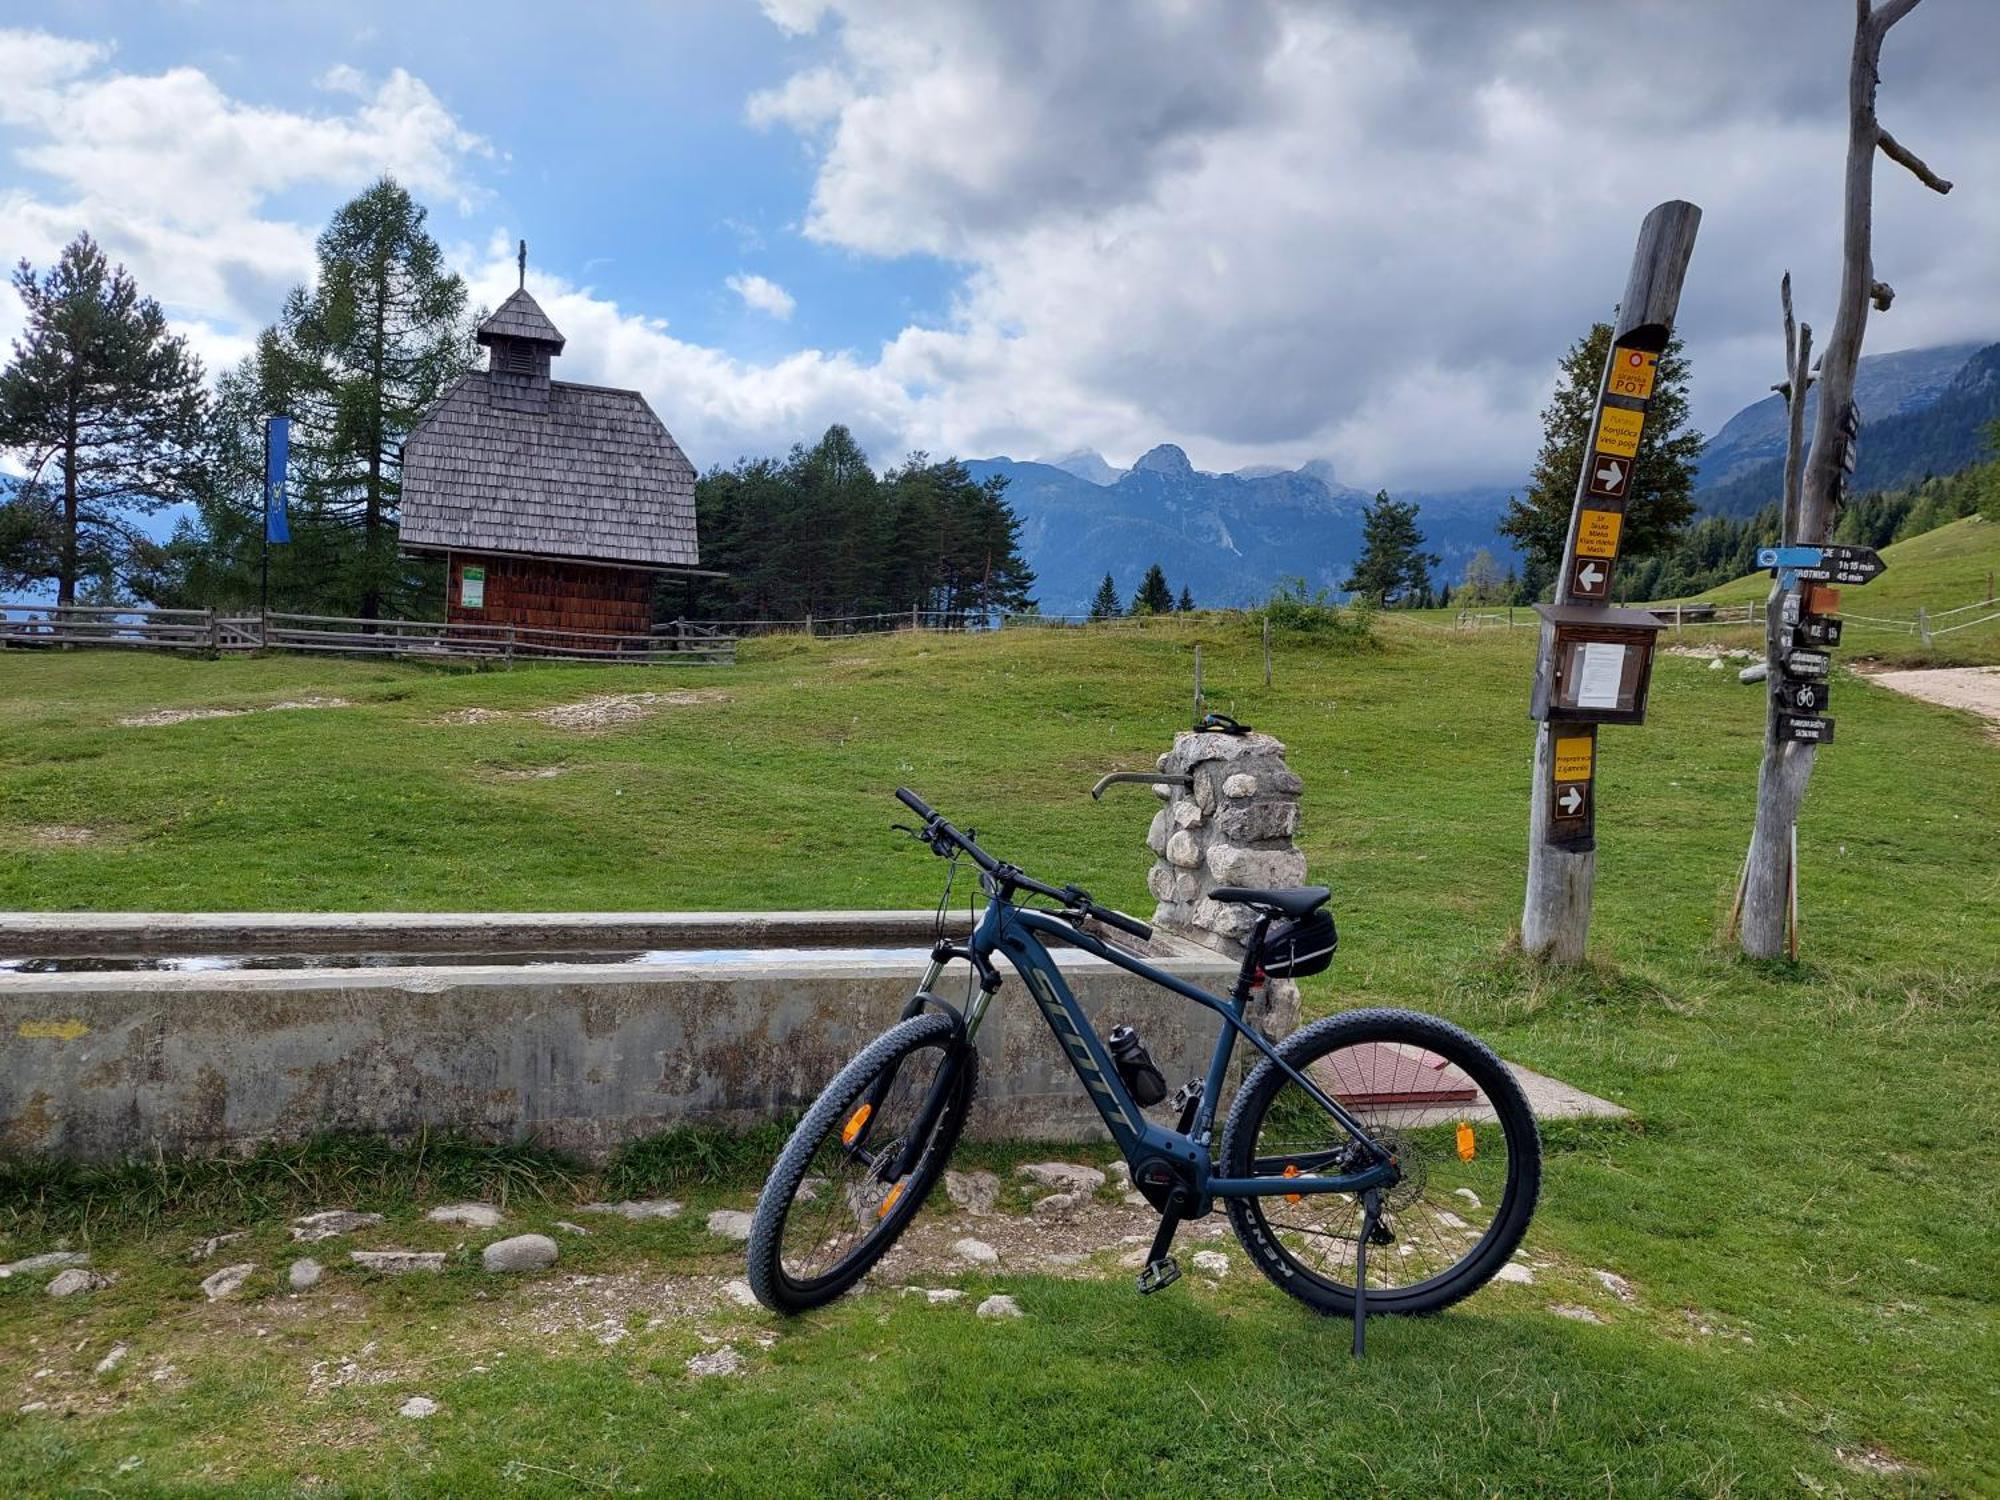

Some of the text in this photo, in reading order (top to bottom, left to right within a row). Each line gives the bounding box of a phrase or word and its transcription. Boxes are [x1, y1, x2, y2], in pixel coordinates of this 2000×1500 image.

[1615, 380, 1646, 393] POT
[1859, 562, 1875, 571] min
[1837, 572, 1848, 581] 45
[1848, 573, 1864, 582] min
[1026, 966, 1138, 1135] SCOTT
